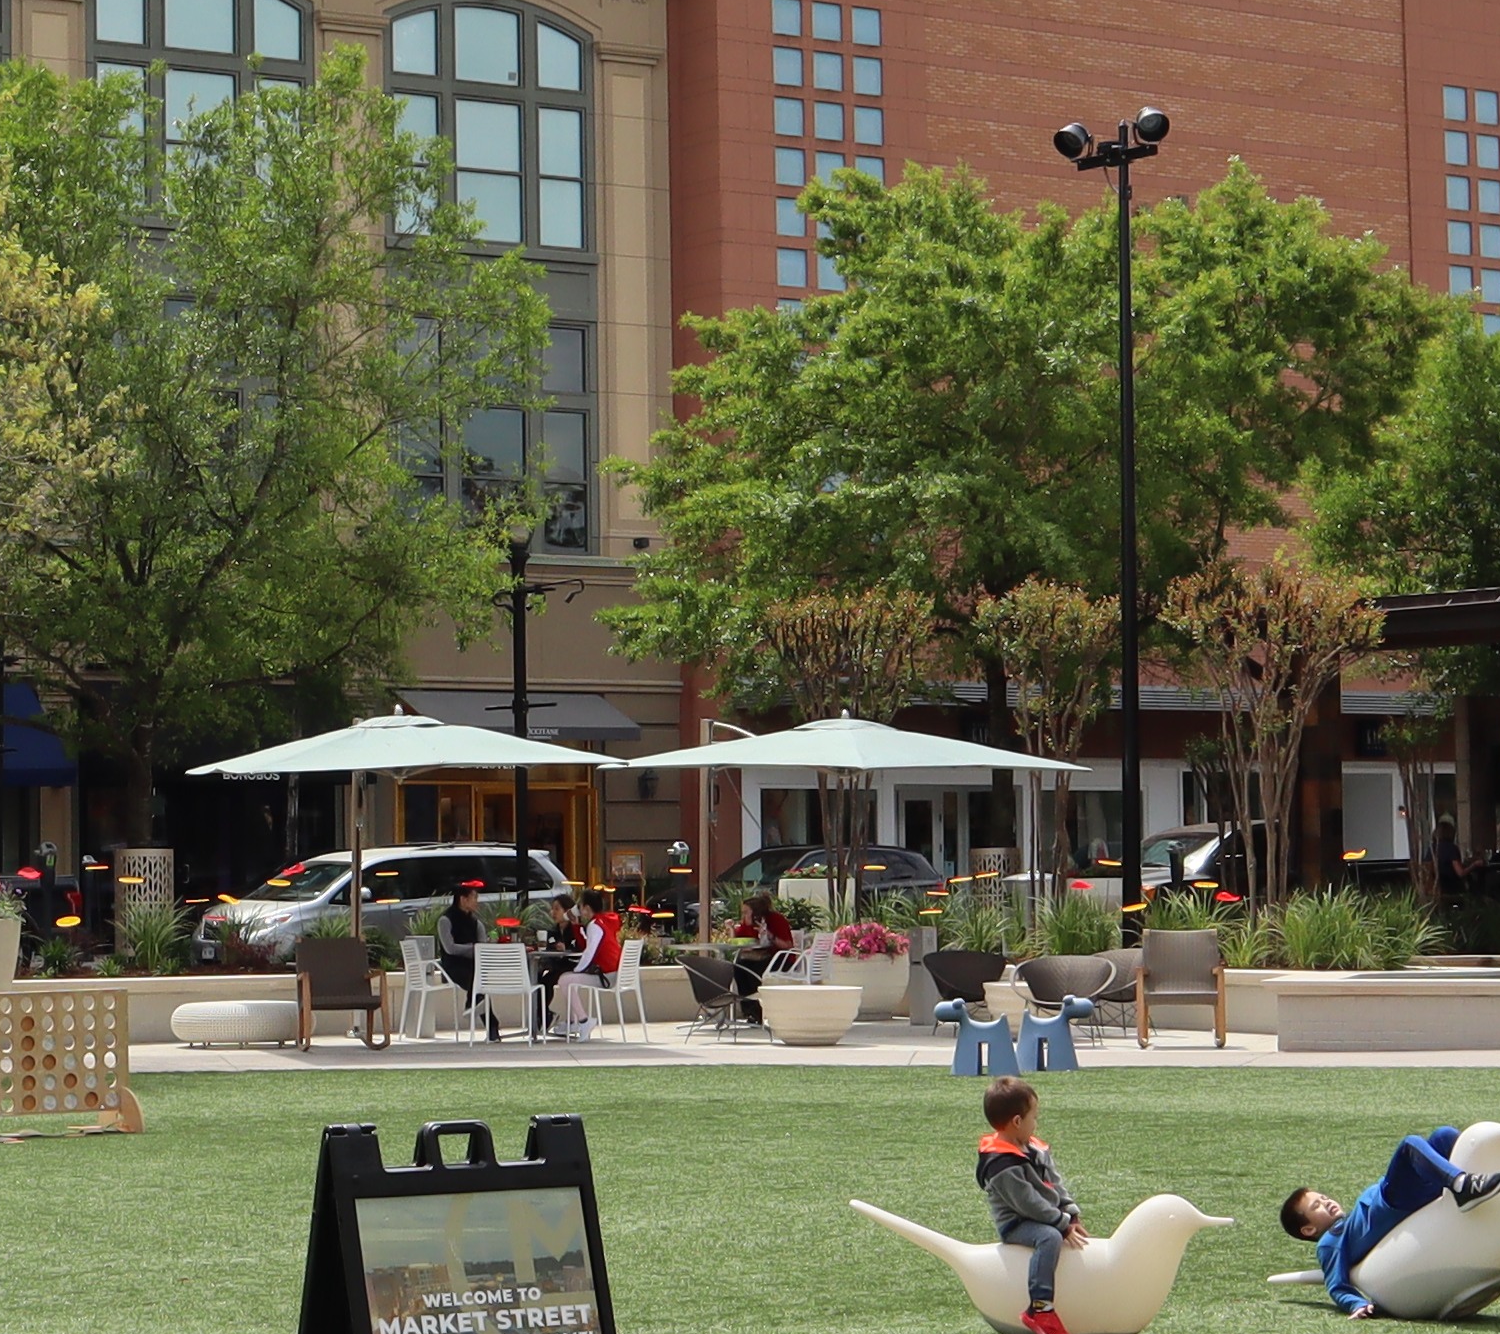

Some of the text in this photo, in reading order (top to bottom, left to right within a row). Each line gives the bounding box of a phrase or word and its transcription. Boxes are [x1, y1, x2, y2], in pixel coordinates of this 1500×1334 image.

[422, 1287, 541, 1308] WELCOME TO
[495, 1304, 592, 1330] STREET
